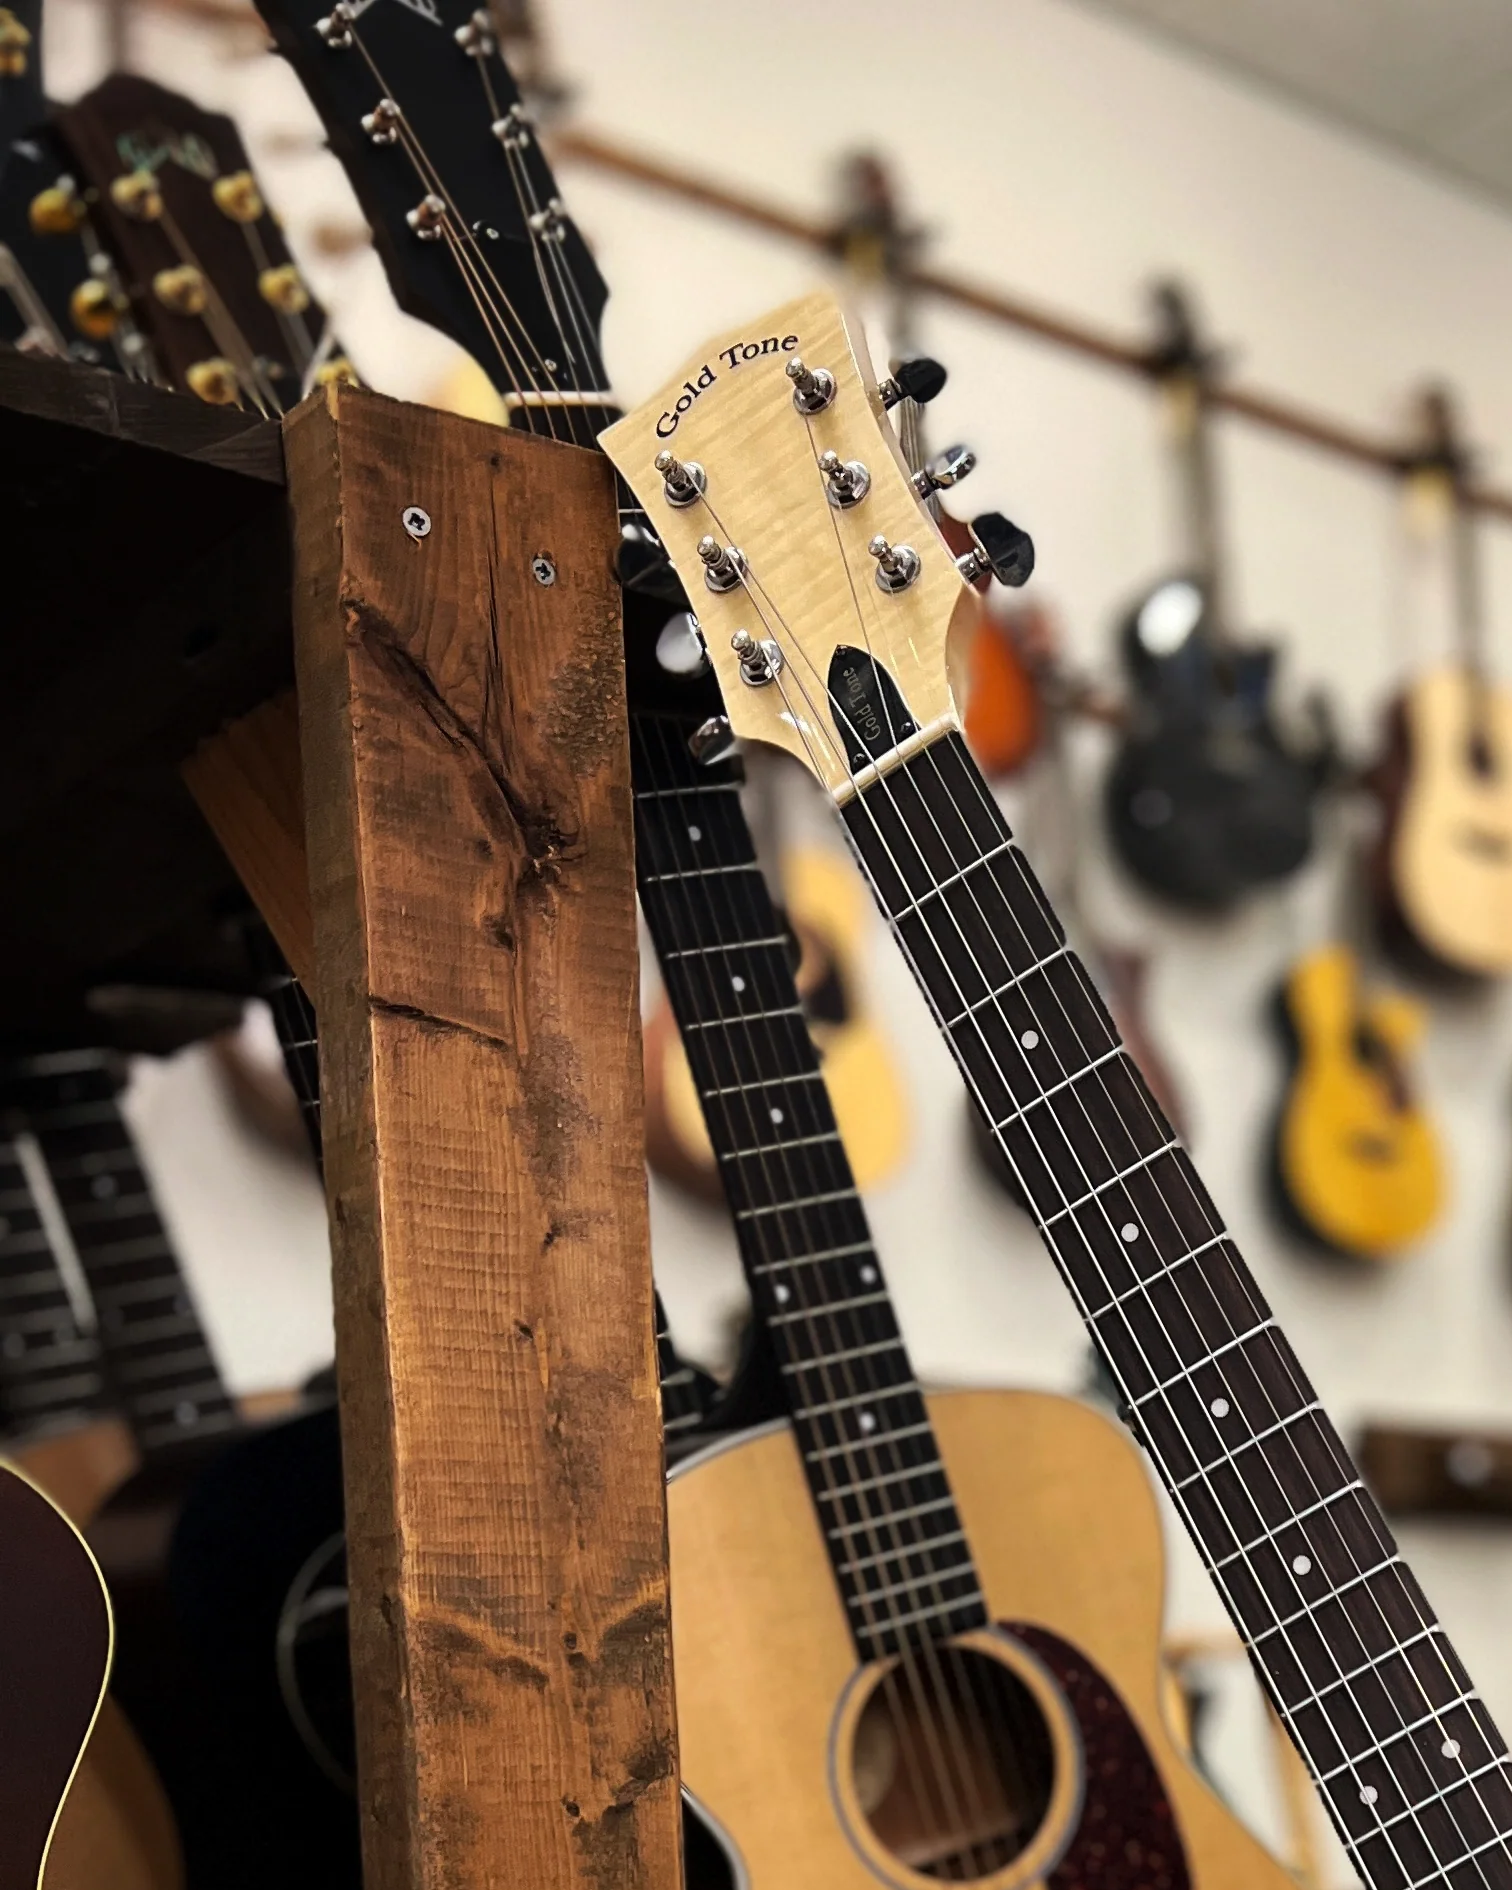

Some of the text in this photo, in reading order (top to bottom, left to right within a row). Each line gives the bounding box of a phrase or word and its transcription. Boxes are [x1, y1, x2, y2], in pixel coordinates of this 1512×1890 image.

[656, 334, 799, 438] Gold Tone
[843, 666, 881, 741] Gold Tone
